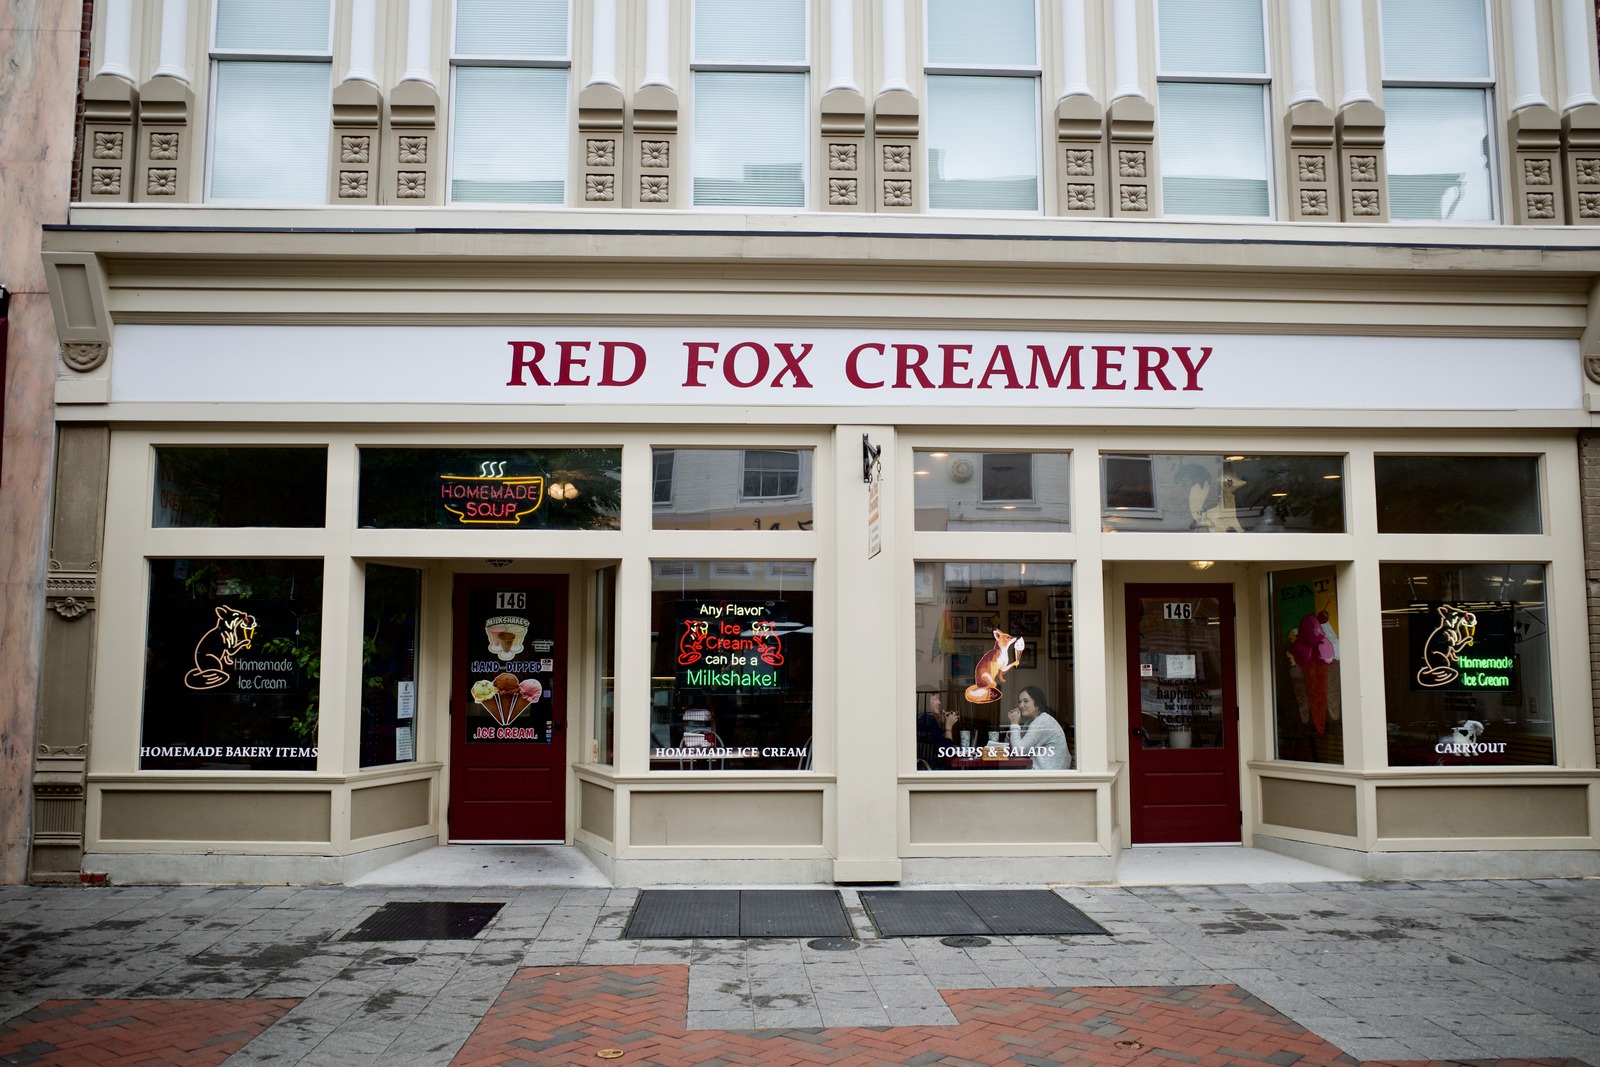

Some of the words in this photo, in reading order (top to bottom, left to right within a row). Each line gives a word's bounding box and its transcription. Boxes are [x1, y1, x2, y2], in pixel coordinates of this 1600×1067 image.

[506, 340, 647, 387] RED
[681, 341, 814, 389] FOX
[845, 342, 1213, 391] CREAMERY
[441, 484, 538, 500] HOMEMADE
[466, 501, 517, 517] SOUP
[1280, 579, 1330, 601] EAT
[498, 593, 526, 609] 146
[699, 604, 722, 618] Any
[726, 604, 764, 616] Flavor
[1165, 603, 1191, 619] 146
[720, 621, 741, 634] Ice
[705, 636, 754, 650] Cream
[234, 658, 293, 671] Homemade
[705, 655, 727, 665] can
[731, 653, 746, 666] be
[750, 656, 758, 666] a
[1459, 656, 1513, 669] Homemade
[471, 660, 542, 673] HAND-DIPPED
[238, 675, 253, 689] Ice
[254, 675, 287, 689] Cream
[687, 669, 777, 687] Milkshake!
[1156, 677, 1172, 686] You
[1463, 672, 1477, 686] Ice
[1478, 672, 1509, 687] Cream
[476, 727, 495, 739] ICE
[497, 727, 535, 739] CREAM
[140, 746, 223, 757] HOMEMADE
[225, 746, 273, 757] BAKERY
[275, 747, 318, 757] ITEMS
[655, 747, 733, 757] HOMEMADE
[737, 747, 759, 757] ICE
[762, 747, 807, 757] CREAM
[938, 746, 983, 758] SOUPS
[988, 746, 998, 757] &
[1002, 746, 1055, 757] SALADS
[1435, 742, 1507, 754] CARRYOUT
